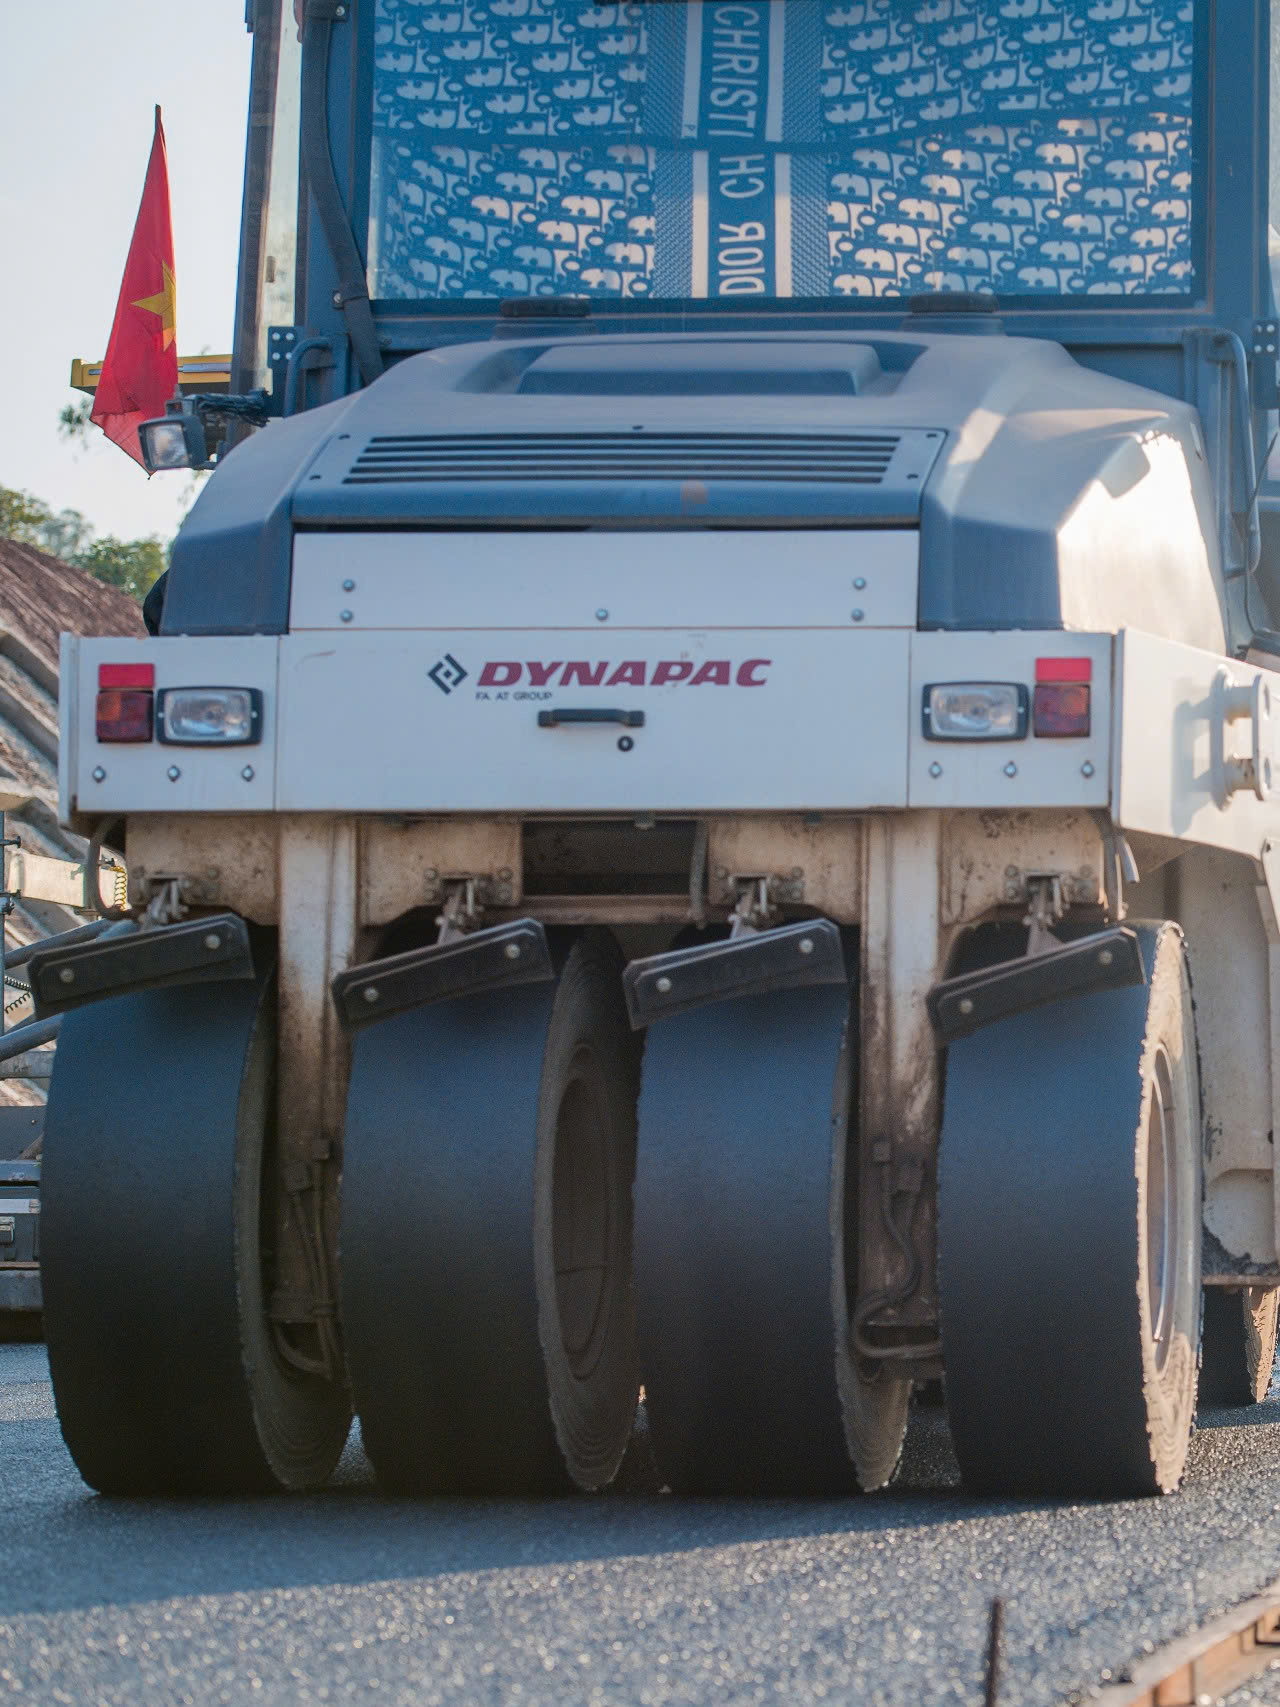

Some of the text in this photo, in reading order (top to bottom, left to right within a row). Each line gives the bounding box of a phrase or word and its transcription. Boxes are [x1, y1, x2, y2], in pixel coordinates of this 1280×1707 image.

[708, 5, 760, 138] CHRISTI
[477, 659, 772, 687] DYNAPAC
[513, 691, 553, 701] GROUP
